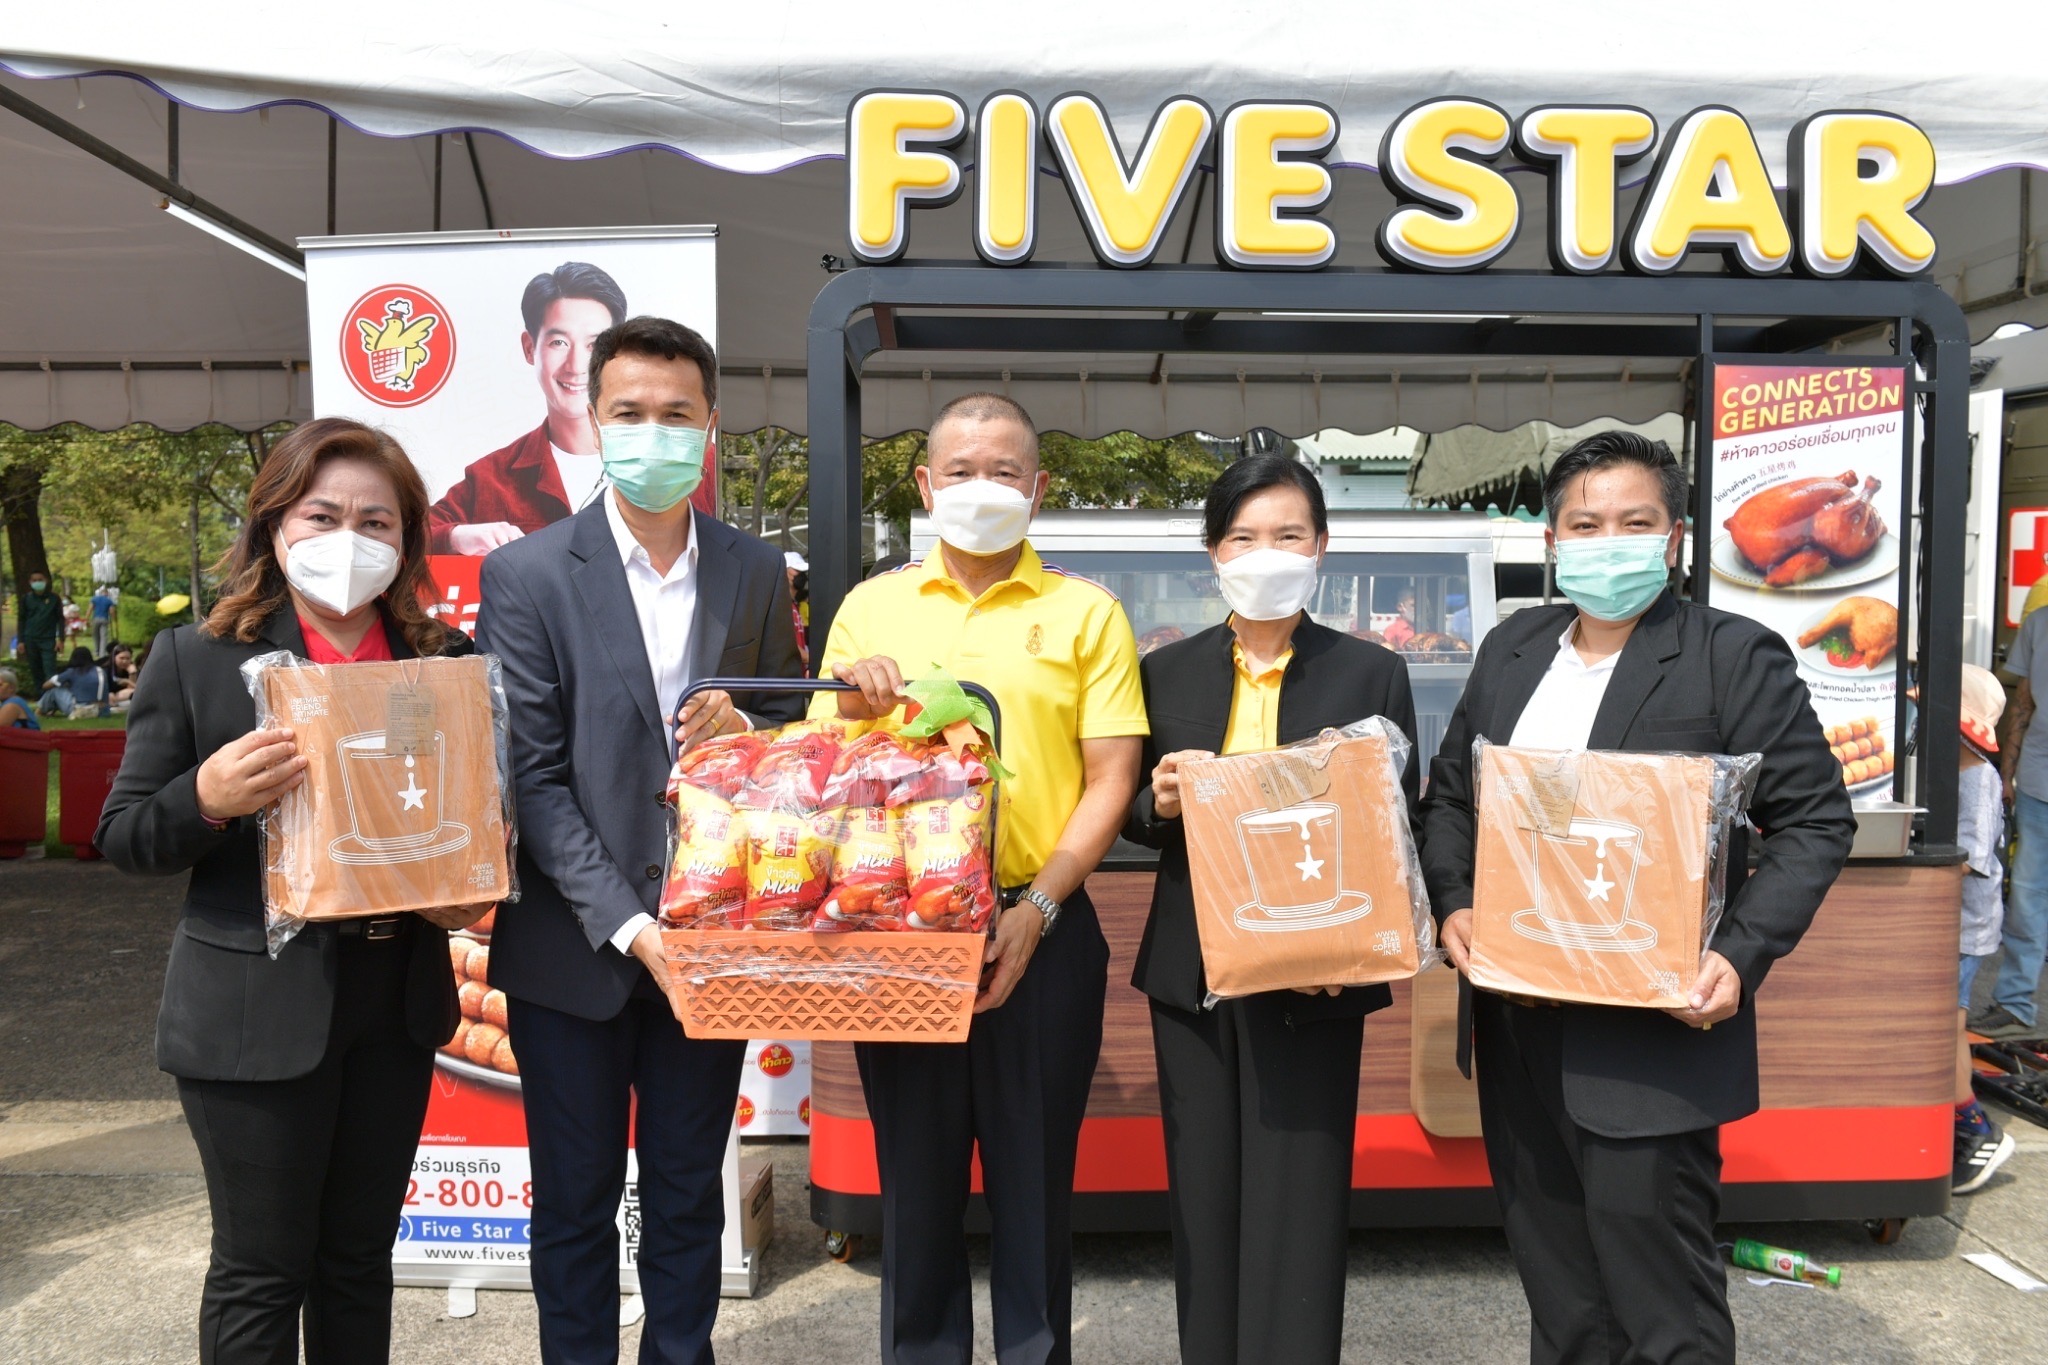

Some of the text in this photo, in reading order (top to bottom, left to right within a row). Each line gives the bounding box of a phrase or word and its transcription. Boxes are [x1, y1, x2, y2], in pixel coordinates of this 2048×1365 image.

[848, 90, 1937, 276] FIVE STAR
[1721, 366, 1873, 410] CONNECTS
[1719, 384, 1900, 433] GENERATION
[1720, 421, 1896, 462] #ห้าดาวอร่อยเชื่อมทุกเจน
[290, 695, 328, 705] INTIMATE
[291, 709, 329, 719] INTIMATE
[684, 858, 730, 877] Mini
[851, 852, 896, 873] Mini
[920, 852, 963, 880] Mini
[467, 874, 495, 884] COFFEE
[760, 878, 805, 897] Mini
[1372, 941, 1401, 951] COFFEE
[1382, 935, 1400, 944] STAR
[761, 1056, 792, 1069] ห้าดาว
[422, 1220, 462, 1238] Five
[472, 1222, 513, 1240] Star
